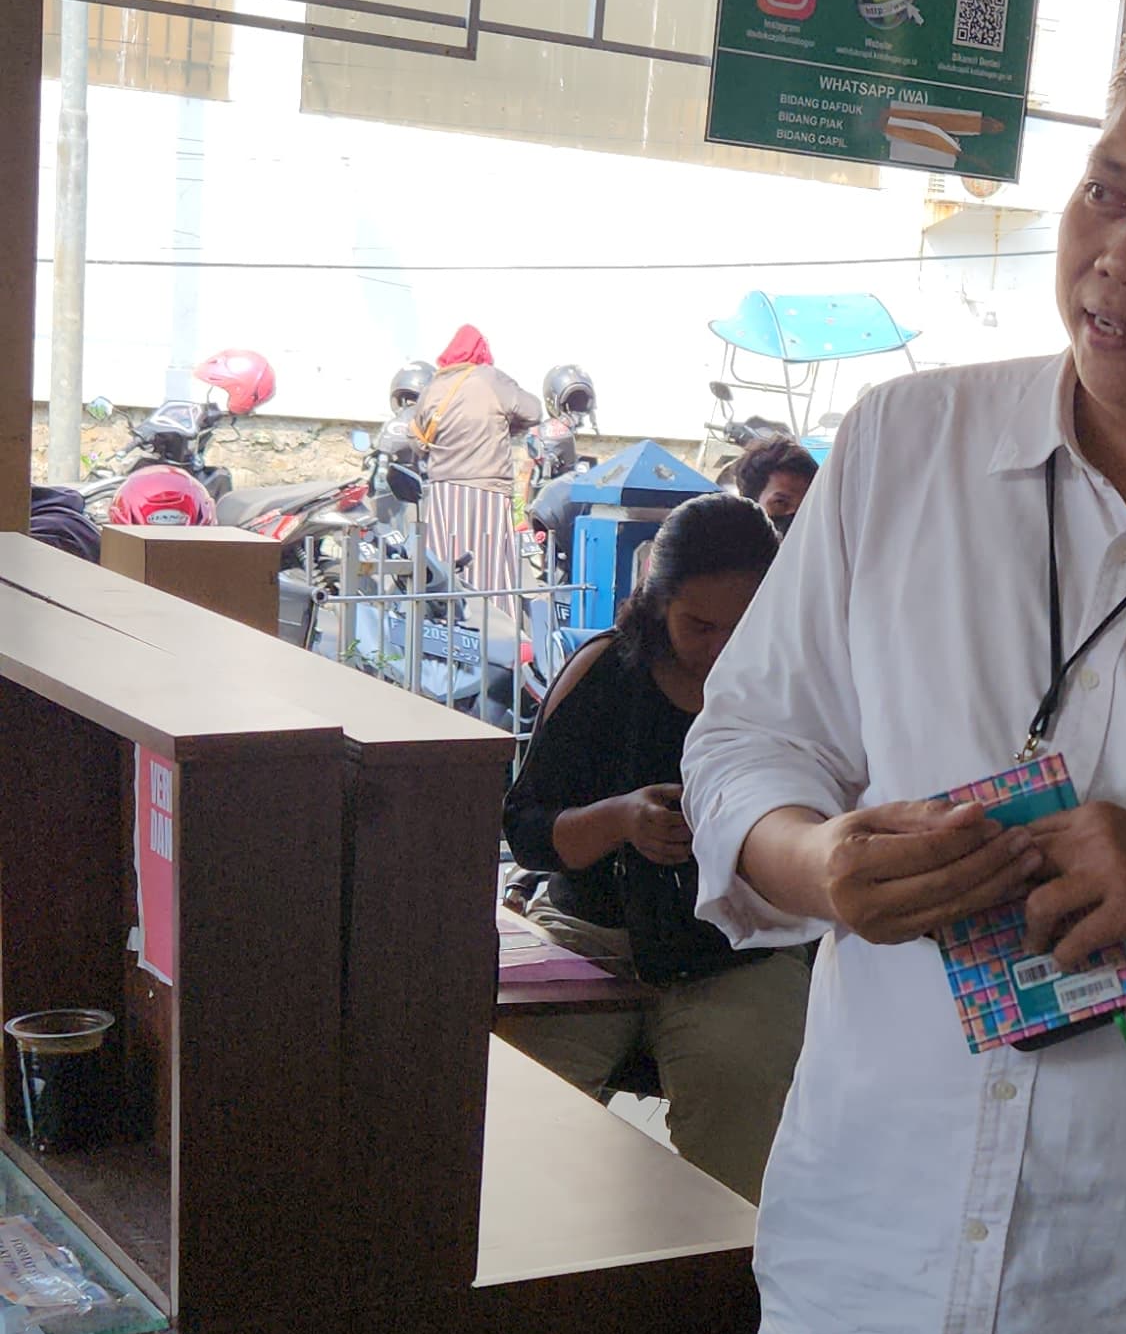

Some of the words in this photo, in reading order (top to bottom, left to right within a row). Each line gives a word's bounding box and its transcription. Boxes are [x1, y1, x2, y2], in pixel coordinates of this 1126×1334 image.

[820, 74, 896, 99] WHATSAPP
[898, 88, 928, 105] (WA)
[780, 93, 820, 109] BIDANG
[821, 99, 864, 116] DAFDUK
[778, 111, 818, 126] BIDANG
[819, 116, 844, 130] PIAK
[776, 128, 816, 144] BIDANG
[818, 134, 847, 148] CAPIL
